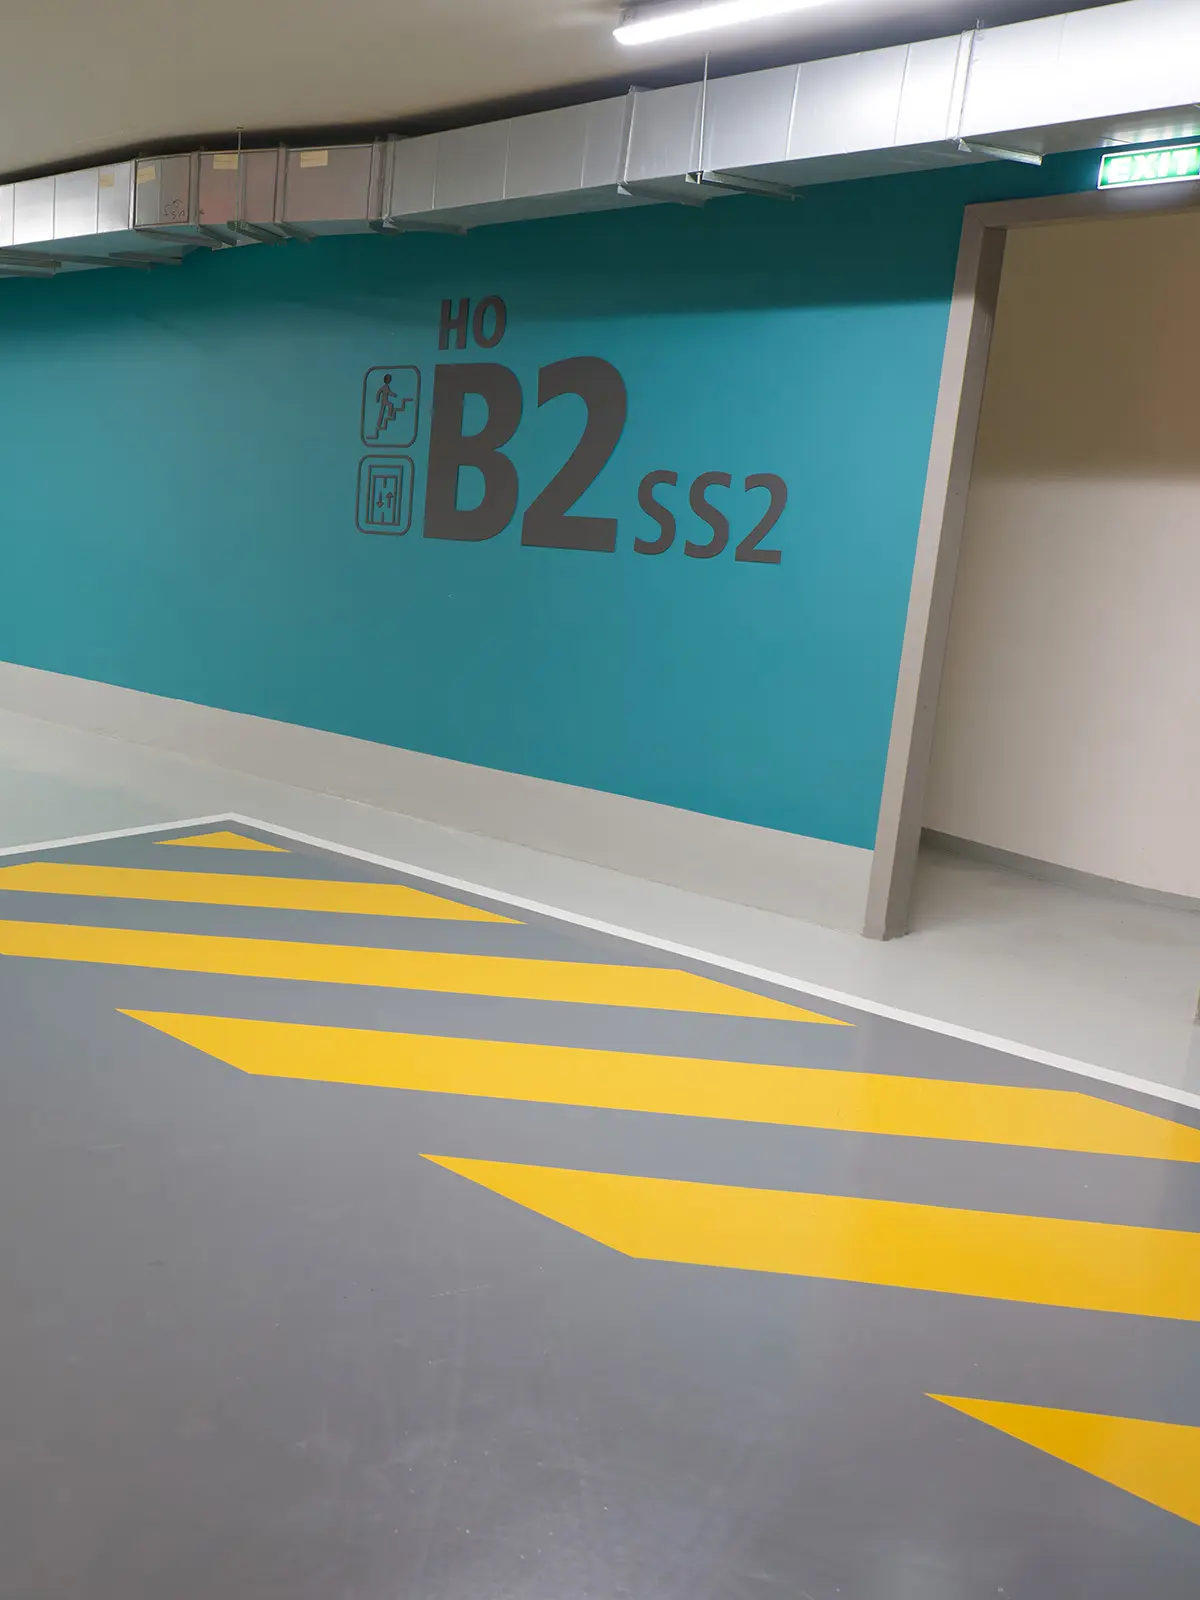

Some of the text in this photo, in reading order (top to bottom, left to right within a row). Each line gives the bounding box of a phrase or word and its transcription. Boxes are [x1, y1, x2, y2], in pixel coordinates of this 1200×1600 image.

[1107, 148, 1198, 184] EXIT
[423, 355, 789, 565] B2 SS2
